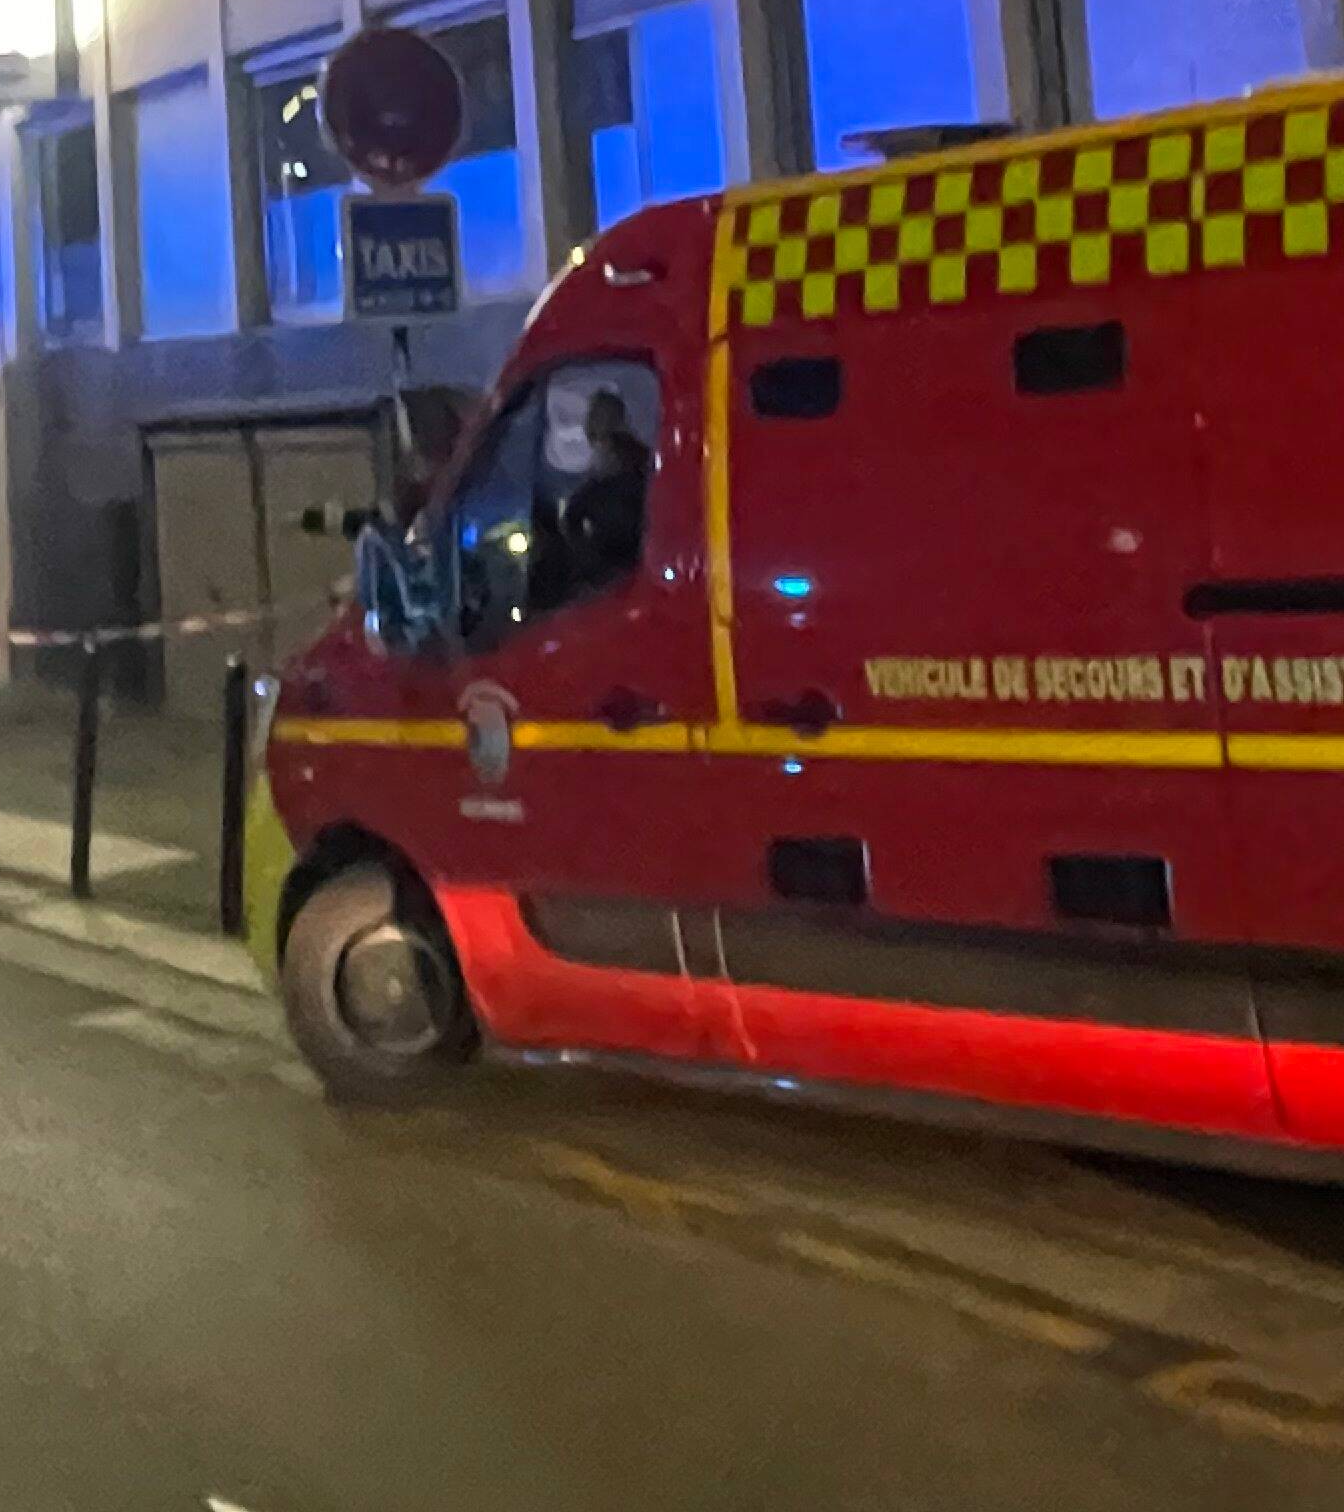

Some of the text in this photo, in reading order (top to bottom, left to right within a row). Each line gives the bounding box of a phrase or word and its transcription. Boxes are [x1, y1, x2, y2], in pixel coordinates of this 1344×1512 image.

[358, 238, 450, 279] TAXIS
[865, 657, 987, 700] VEHICULE
[992, 657, 1029, 702] DE
[1035, 656, 1164, 702] SECOURS
[1168, 656, 1207, 702] ET
